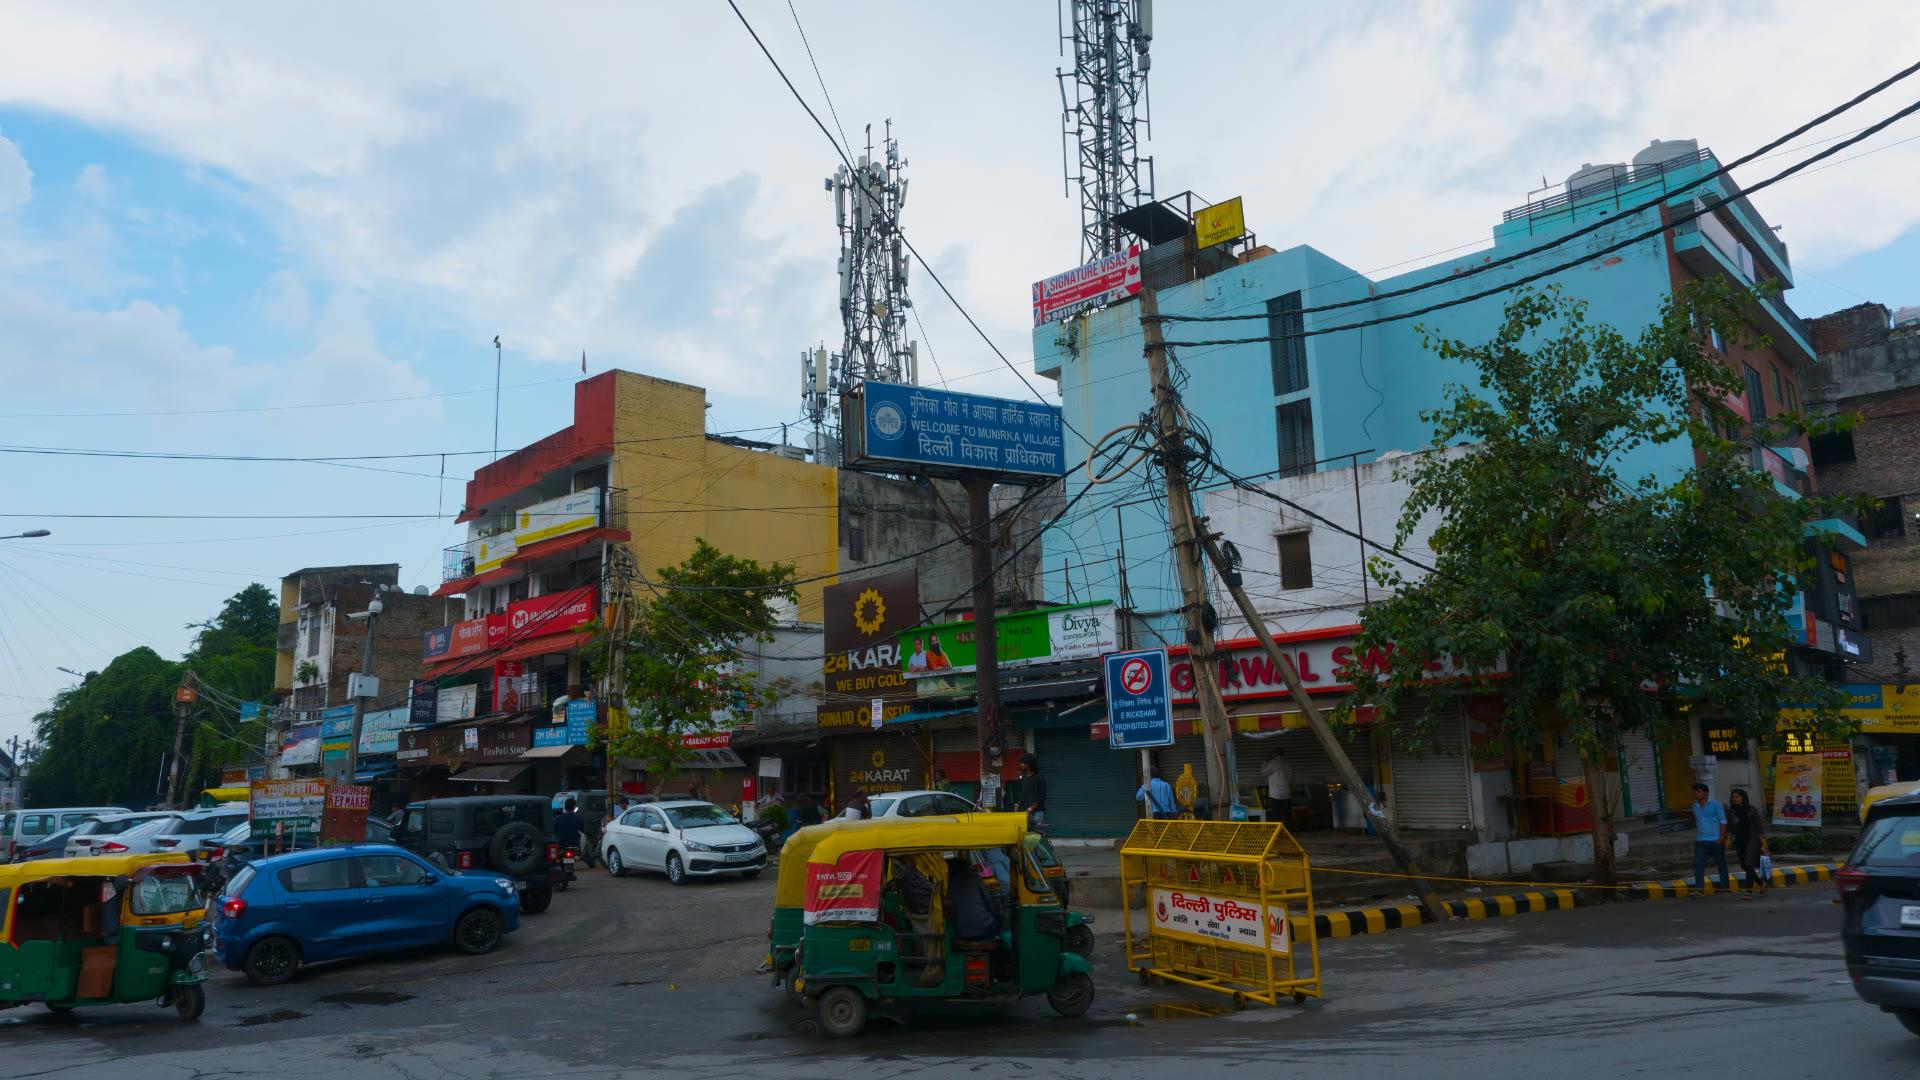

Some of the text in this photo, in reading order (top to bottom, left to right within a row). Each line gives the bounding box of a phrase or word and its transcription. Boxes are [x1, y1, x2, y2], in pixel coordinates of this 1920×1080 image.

[1049, 251, 1128, 291] SIGNATURE VISAS
[910, 390, 939, 418] मुनिरका
[972, 404, 997, 422] आपका
[1002, 402, 1025, 426] हार्दिक
[1028, 411, 1051, 428] स्वागत
[911, 420, 1061, 447] WELCOME TO MUNIRKA VILLAGE
[917, 433, 1056, 469] दिल्ली विकास प्राधिकरण
[1063, 616, 1100, 633] Divya
[824, 645, 902, 674] 24KARA
[1170, 653, 1318, 691] GRWL
[836, 672, 907, 692] WE BUY GOLD
[1120, 709, 1157, 720] E RICKSHAW
[1114, 720, 1165, 731] PROHIBITED ZONE
[1708, 729, 1721, 739] WE
[688, 735, 729, 746] RAILWAY CUET
[848, 768, 911, 784] 24KARAT
[328, 796, 369, 808] KEY MAKER
[1171, 892, 1257, 921] दिल्ली पुलिस
[1206, 920, 1220, 929] सेवा
[1238, 927, 1257, 937] न्याय
